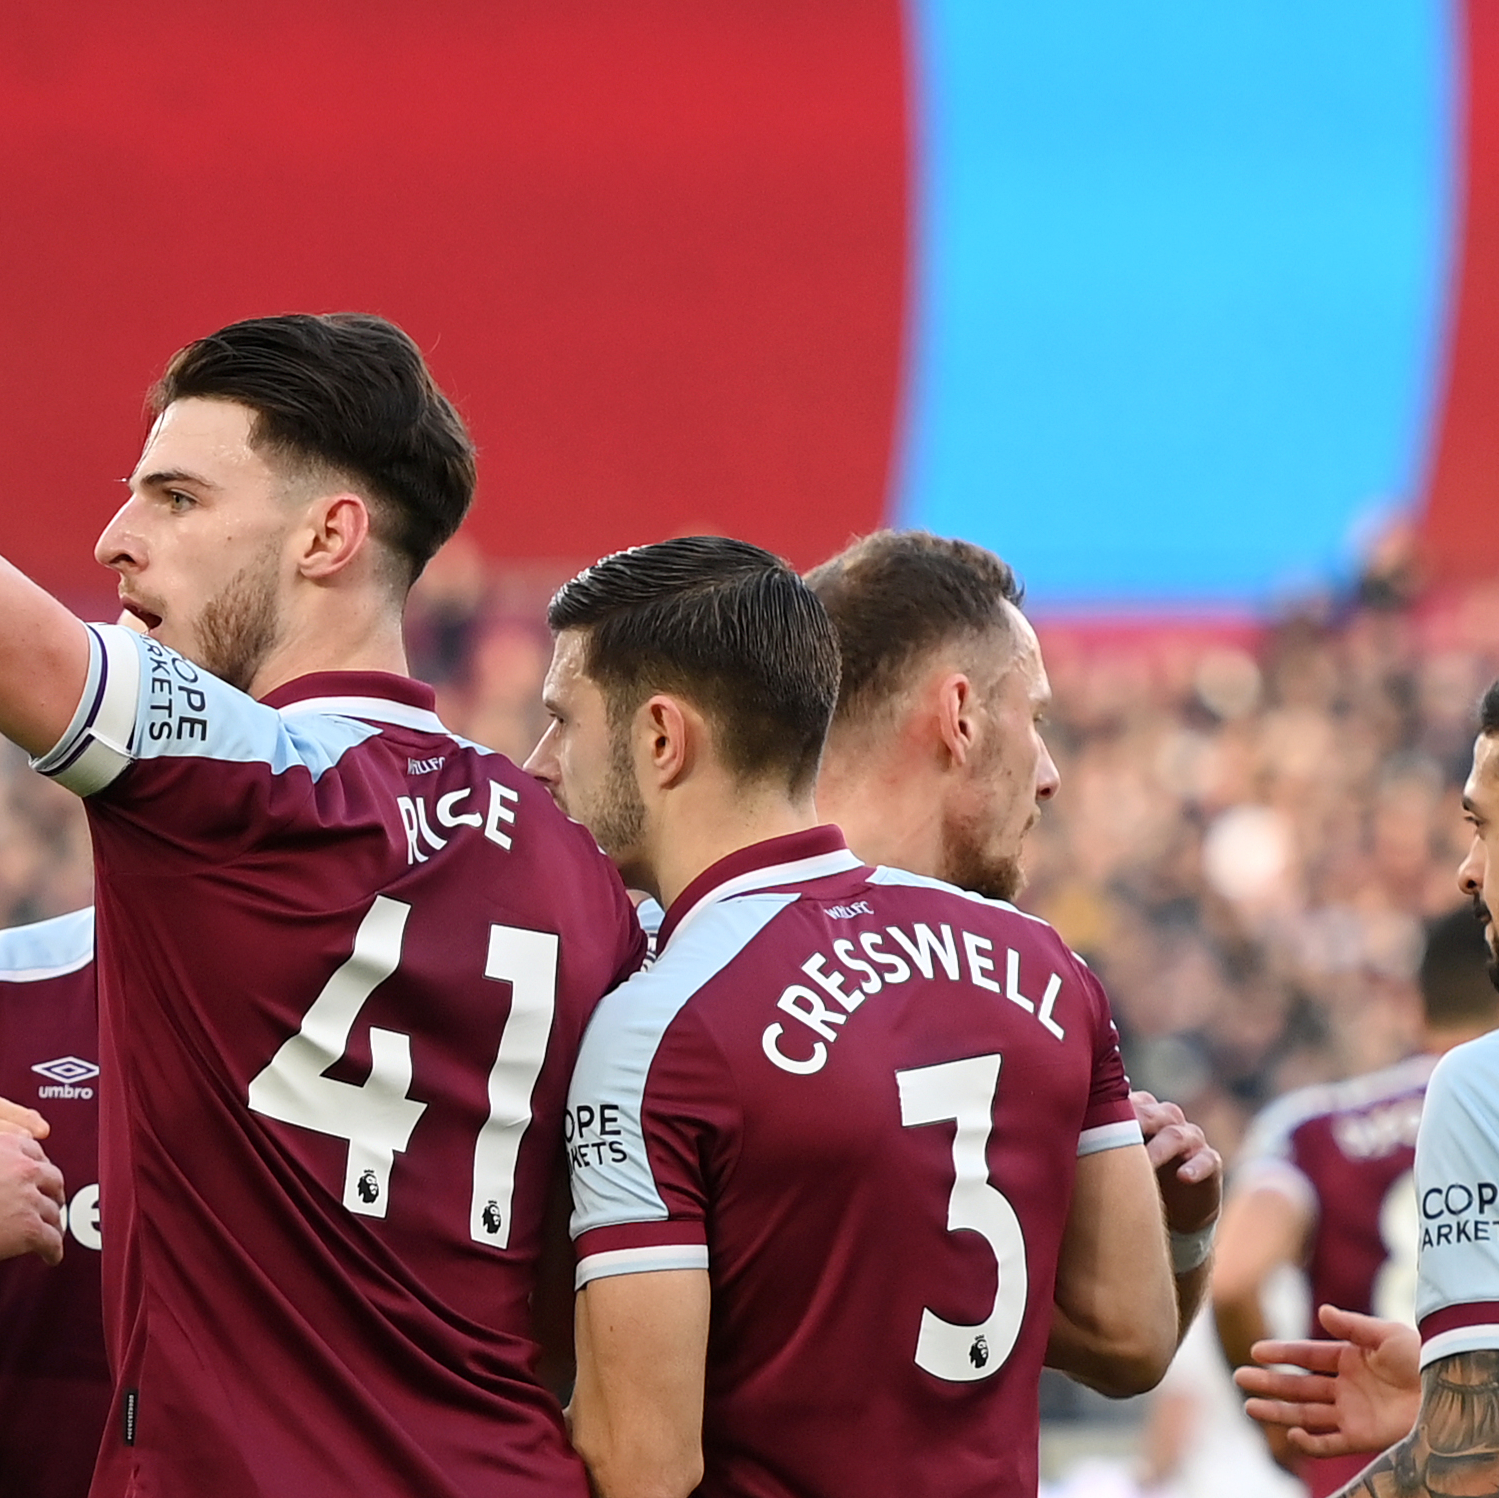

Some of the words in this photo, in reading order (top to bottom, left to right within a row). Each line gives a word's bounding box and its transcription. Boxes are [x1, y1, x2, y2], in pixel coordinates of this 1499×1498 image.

[140, 635, 172, 740] RKETS
[162, 645, 208, 741] OPE
[396, 779, 519, 866] RICE
[761, 922, 1065, 1076] CRESSWELL
[38, 1084, 93, 1100] umbro
[248, 894, 560, 1250] 41
[567, 1141, 628, 1176] KETS
[896, 1053, 1028, 1382] 3
